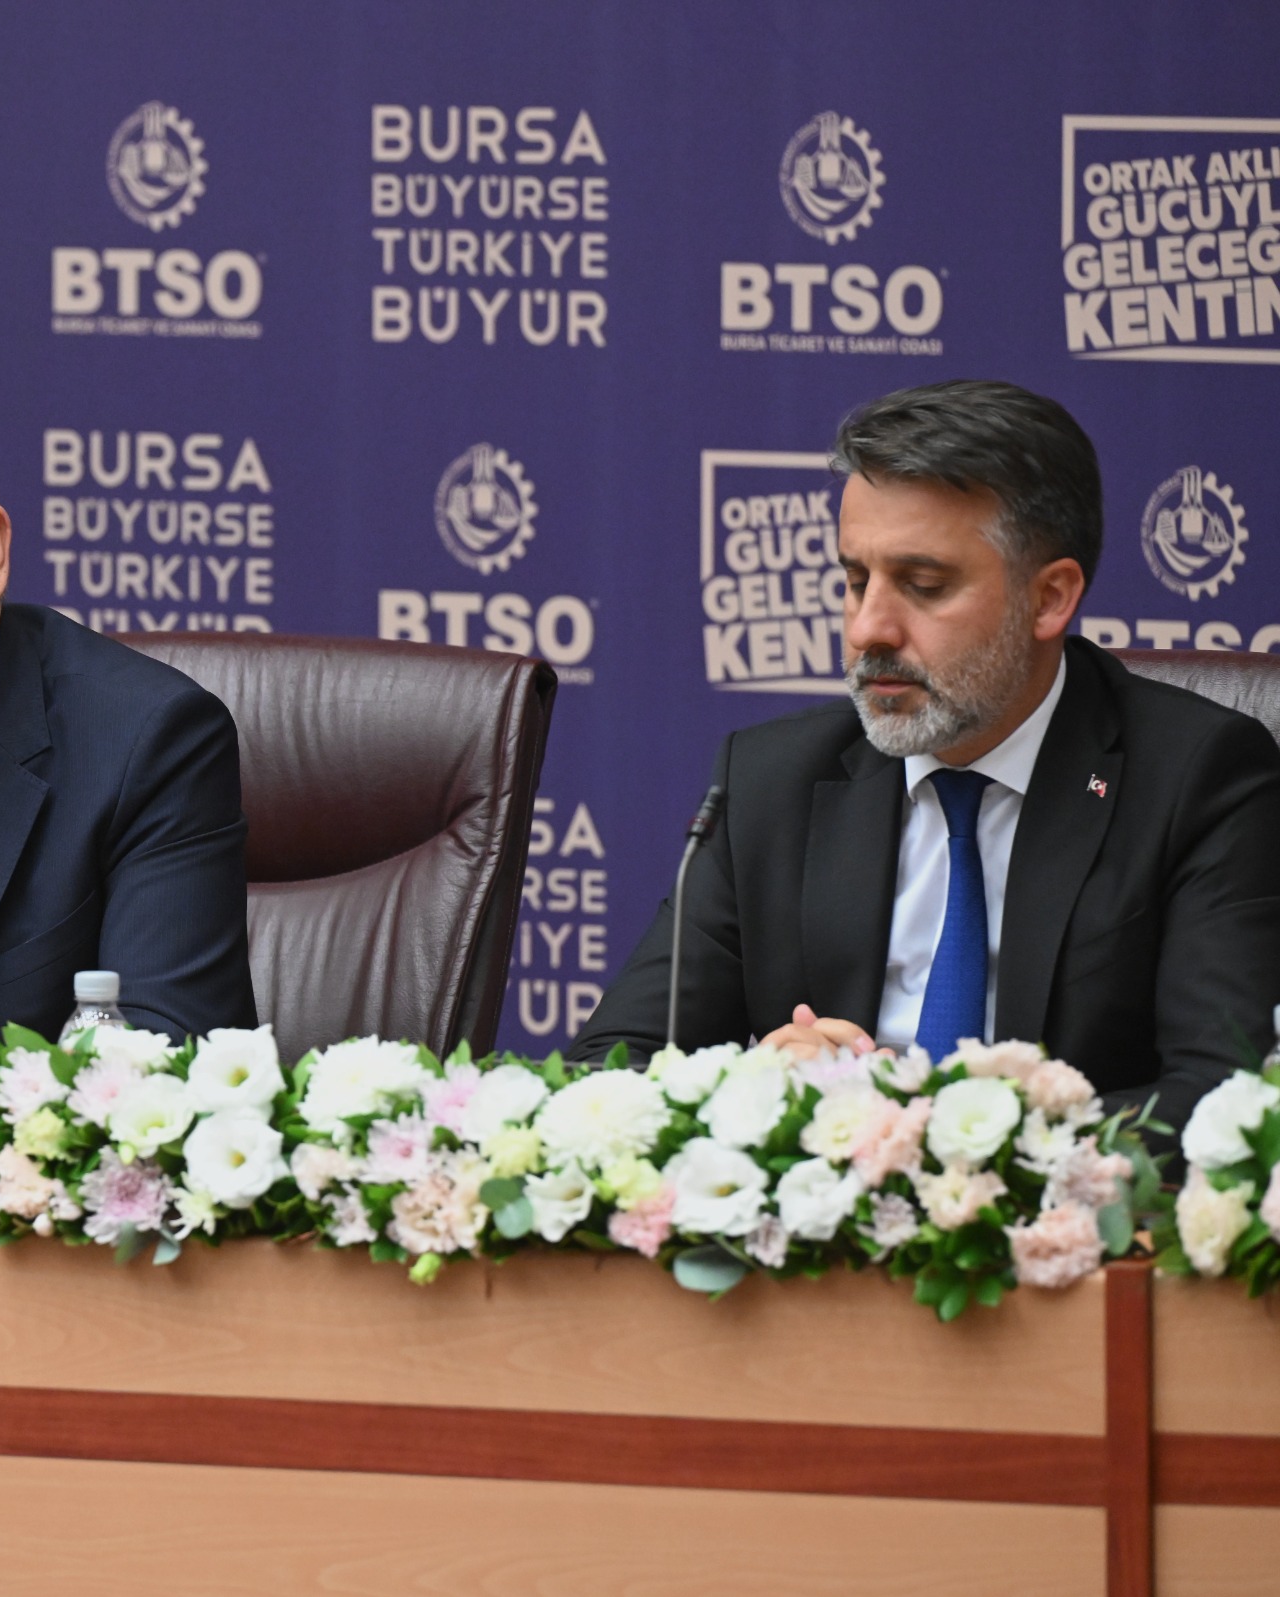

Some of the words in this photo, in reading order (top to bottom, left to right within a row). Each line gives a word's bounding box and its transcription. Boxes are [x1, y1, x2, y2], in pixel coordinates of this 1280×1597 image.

[371, 105, 607, 165] BURSA
[371, 174, 608, 220] BÜYÜRSE
[1083, 155, 1198, 196] ORTAK
[1205, 147, 1280, 185] AKLI
[1086, 181, 1280, 241] GÜCÜYL
[52, 247, 262, 318] BTSO
[372, 228, 608, 278] TÜRKİYE
[1063, 222, 1280, 291] GELECEĞ
[372, 286, 608, 347] BÜYÜR
[721, 262, 943, 334] BTSO
[1064, 276, 1280, 352] KENTİN
[43, 429, 271, 493] BURSA
[43, 497, 274, 547] BÜYÜRSE
[721, 491, 832, 531] ORTAK
[44, 550, 273, 604] TÜRKİYE
[378, 589, 594, 665] BTSO
